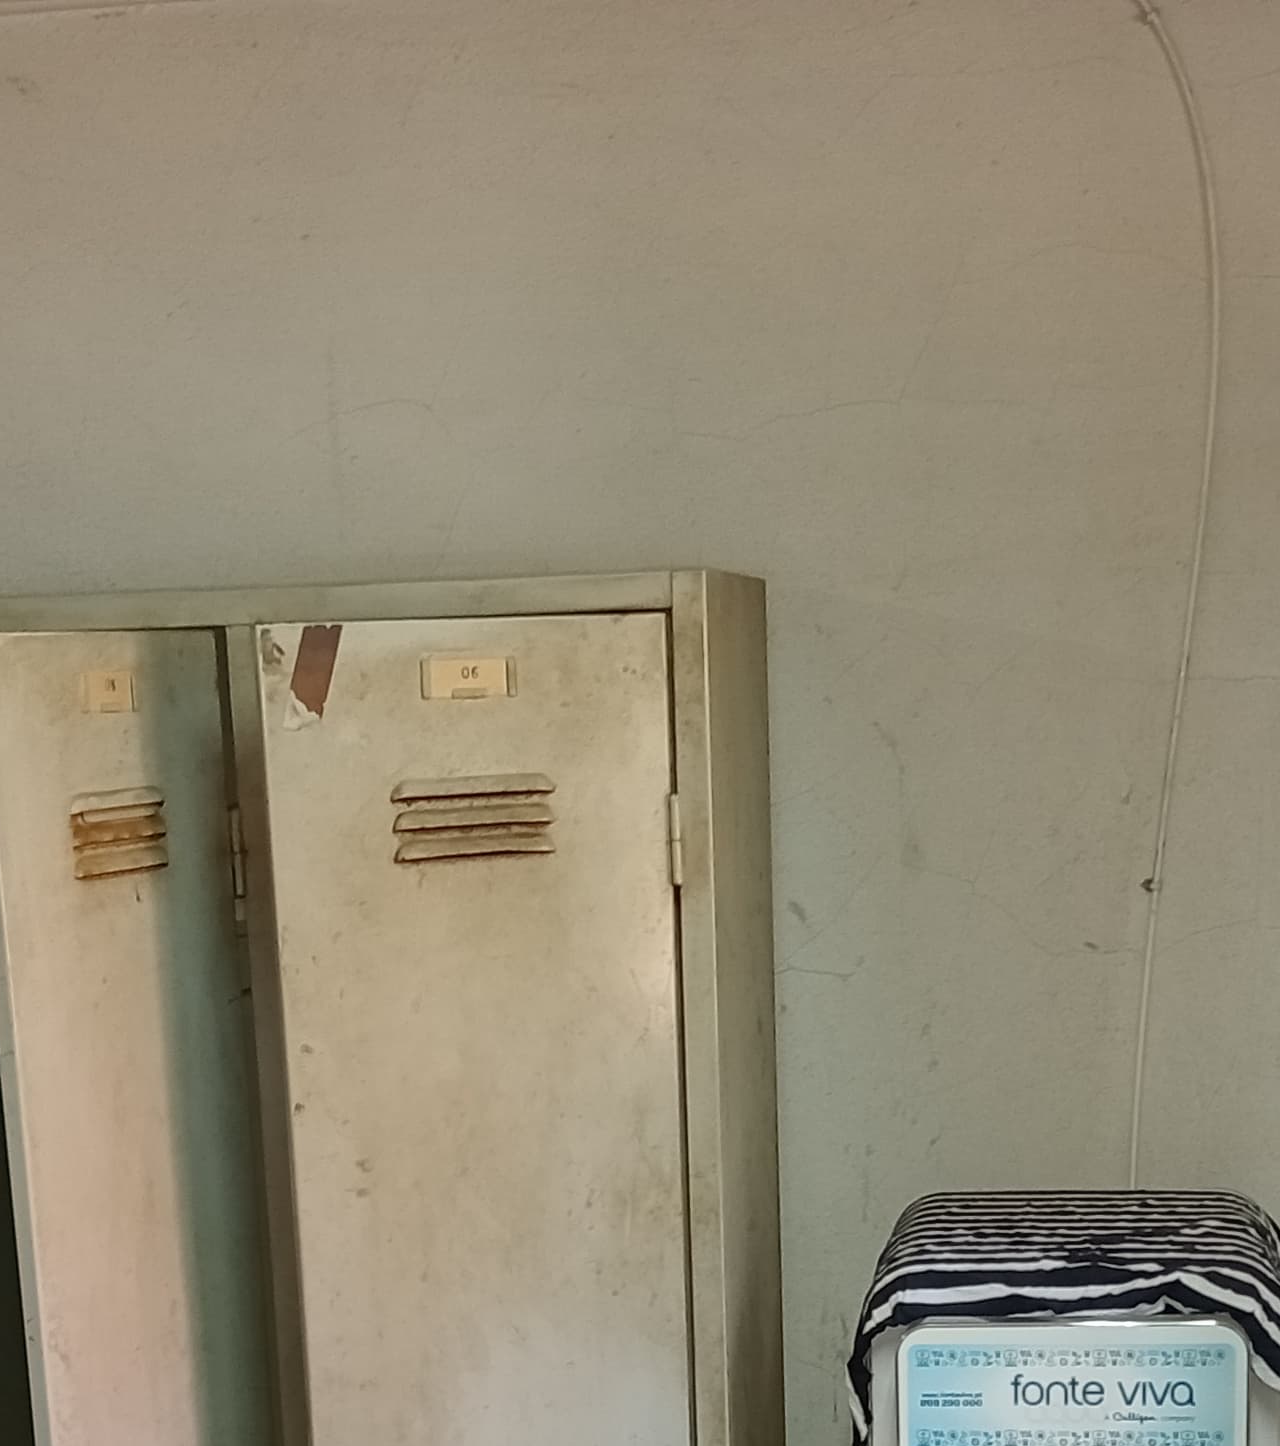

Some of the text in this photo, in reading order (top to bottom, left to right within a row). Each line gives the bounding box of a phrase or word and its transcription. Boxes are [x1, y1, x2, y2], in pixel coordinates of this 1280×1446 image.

[461, 665, 479, 680] 06
[1010, 1374, 1196, 1407] fonte viva
